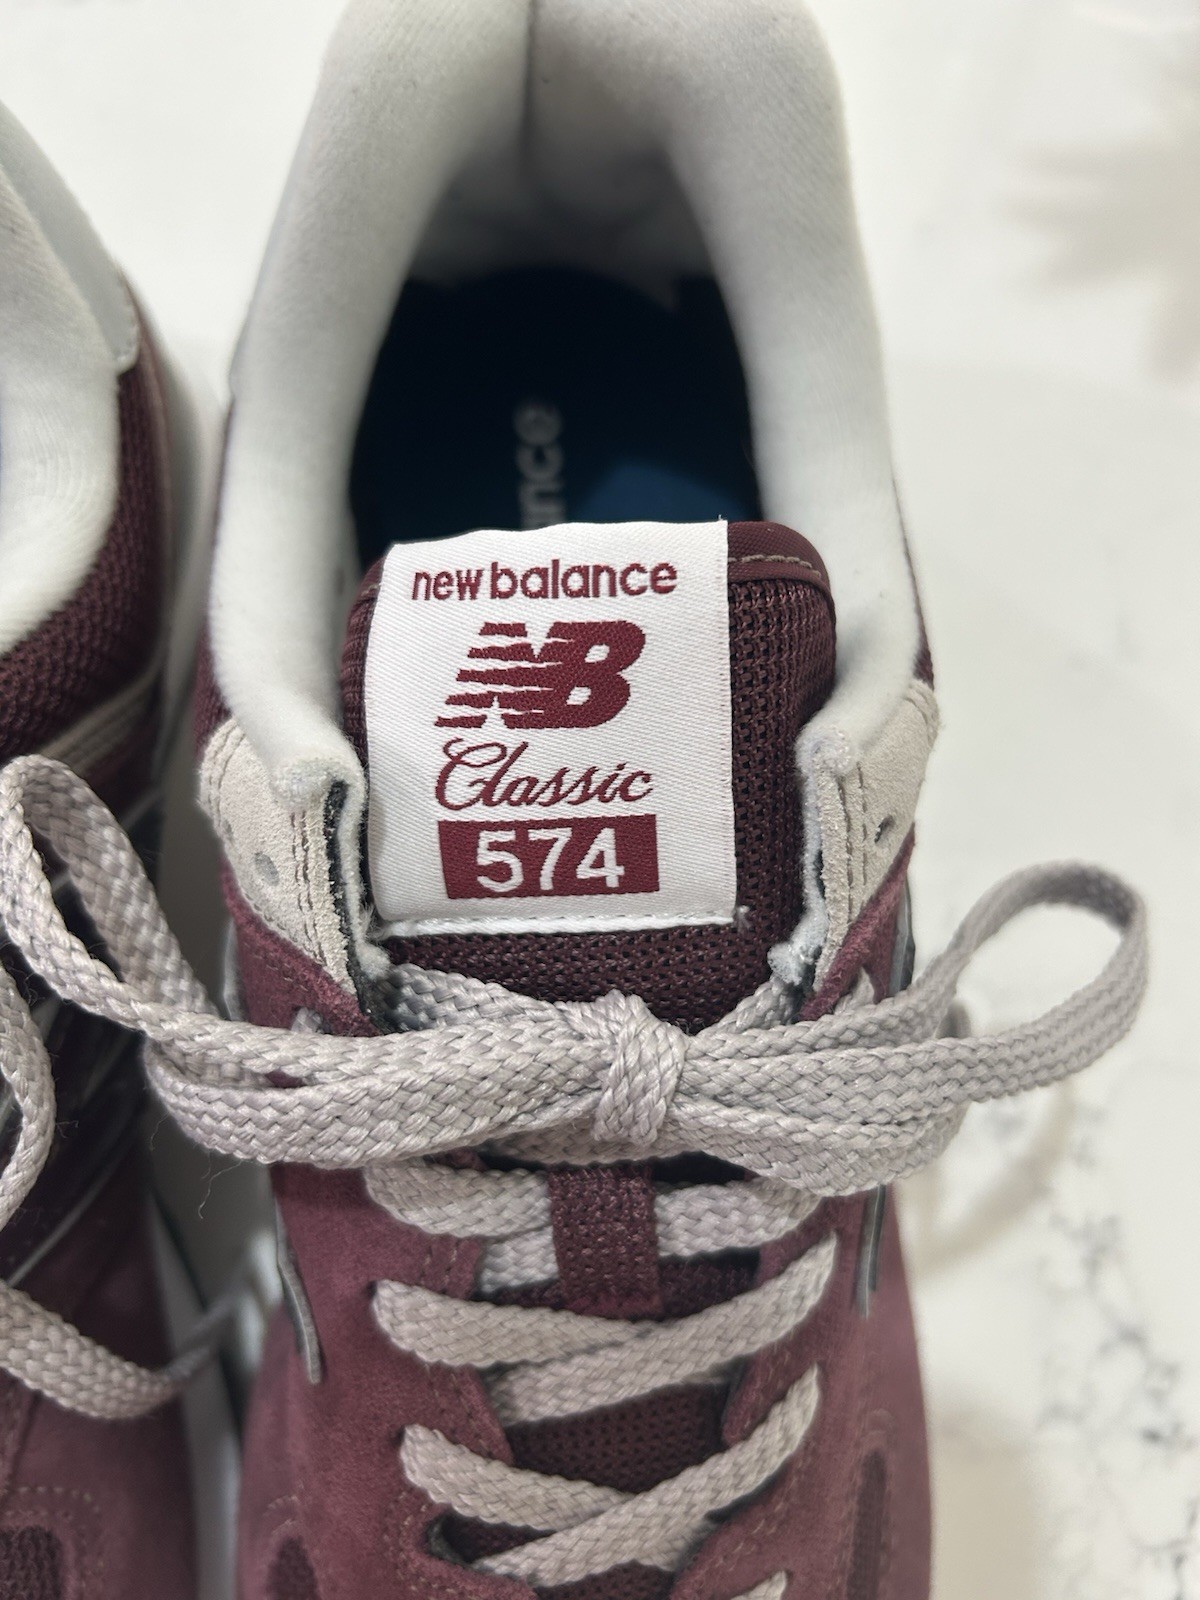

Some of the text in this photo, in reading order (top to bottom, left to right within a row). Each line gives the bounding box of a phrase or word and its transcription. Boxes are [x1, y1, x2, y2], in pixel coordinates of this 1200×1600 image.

[515, 405, 565, 529] nce
[412, 559, 678, 601] new balance
[434, 620, 646, 729] NB
[435, 737, 654, 811] Classic
[477, 827, 625, 892] 574
